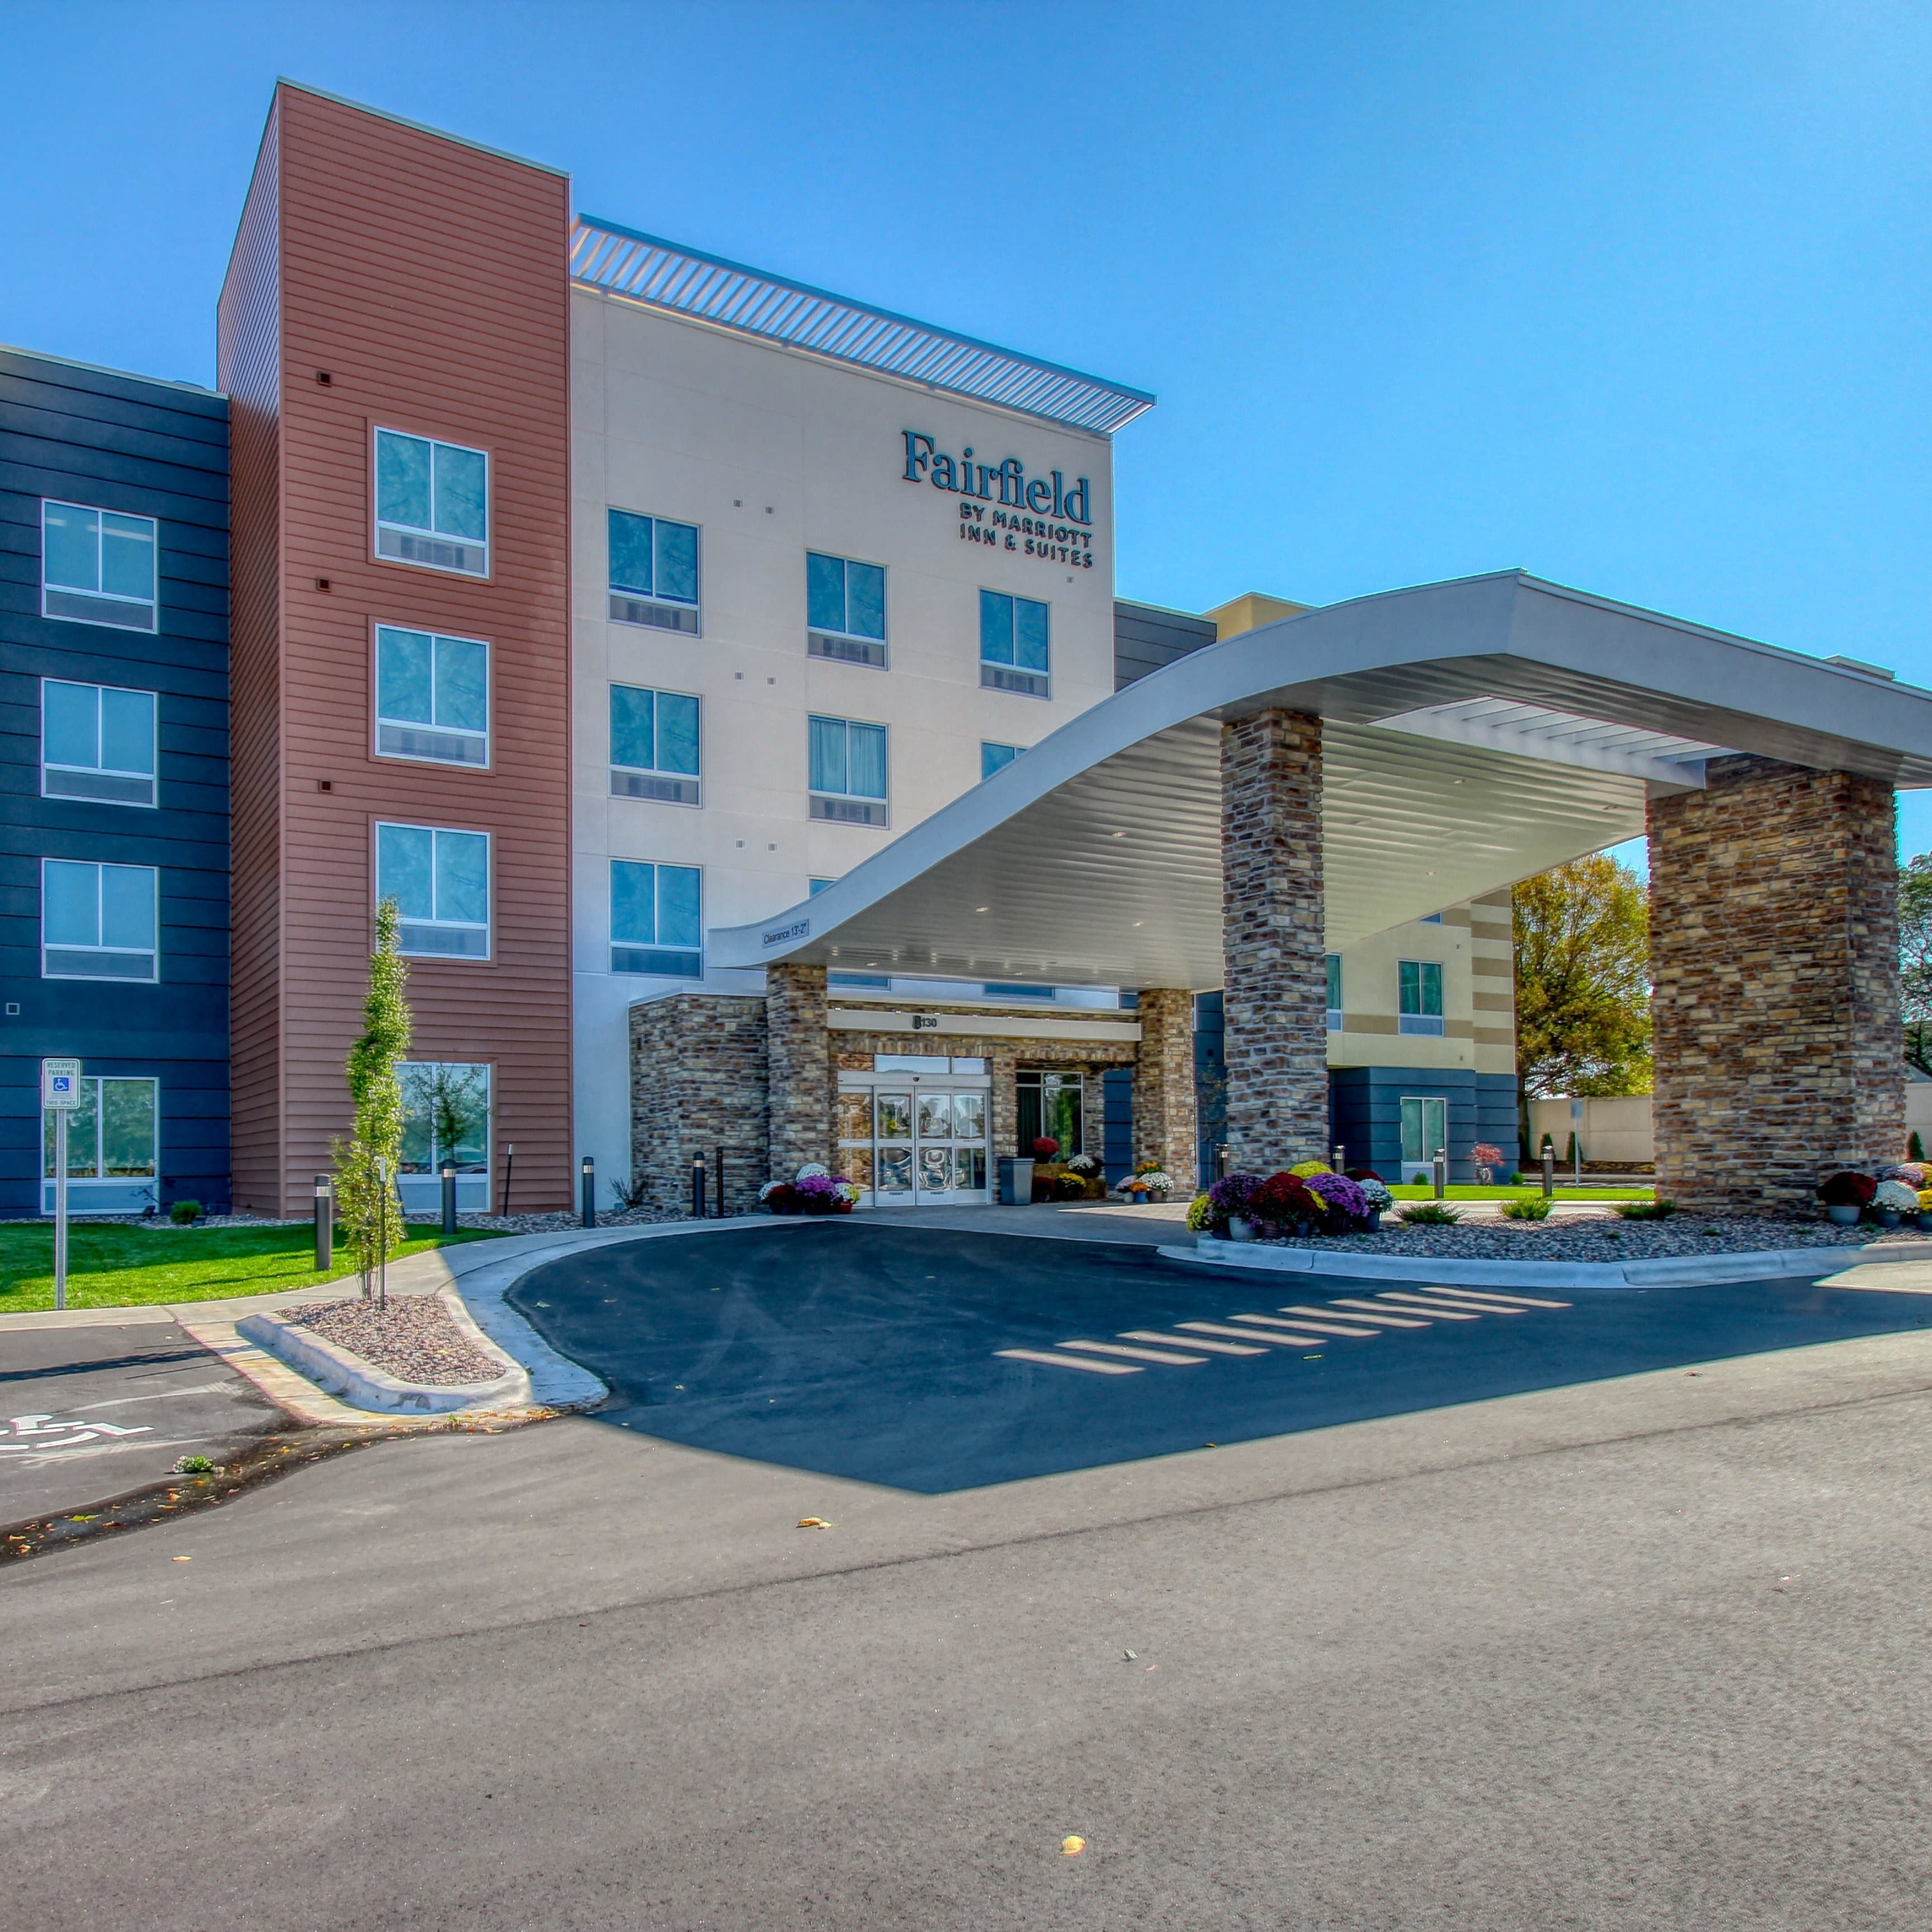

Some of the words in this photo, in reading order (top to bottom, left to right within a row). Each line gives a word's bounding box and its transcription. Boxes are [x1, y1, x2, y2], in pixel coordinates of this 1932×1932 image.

[901, 430, 1092, 526] Fairfield
[960, 502, 985, 521] BY
[993, 510, 1093, 549] MARRIOTT
[960, 523, 996, 546] INN
[1004, 534, 1017, 551] &
[1024, 538, 1093, 568] SUITES
[764, 930, 790, 944] Clearance
[922, 1017, 937, 1027] 130
